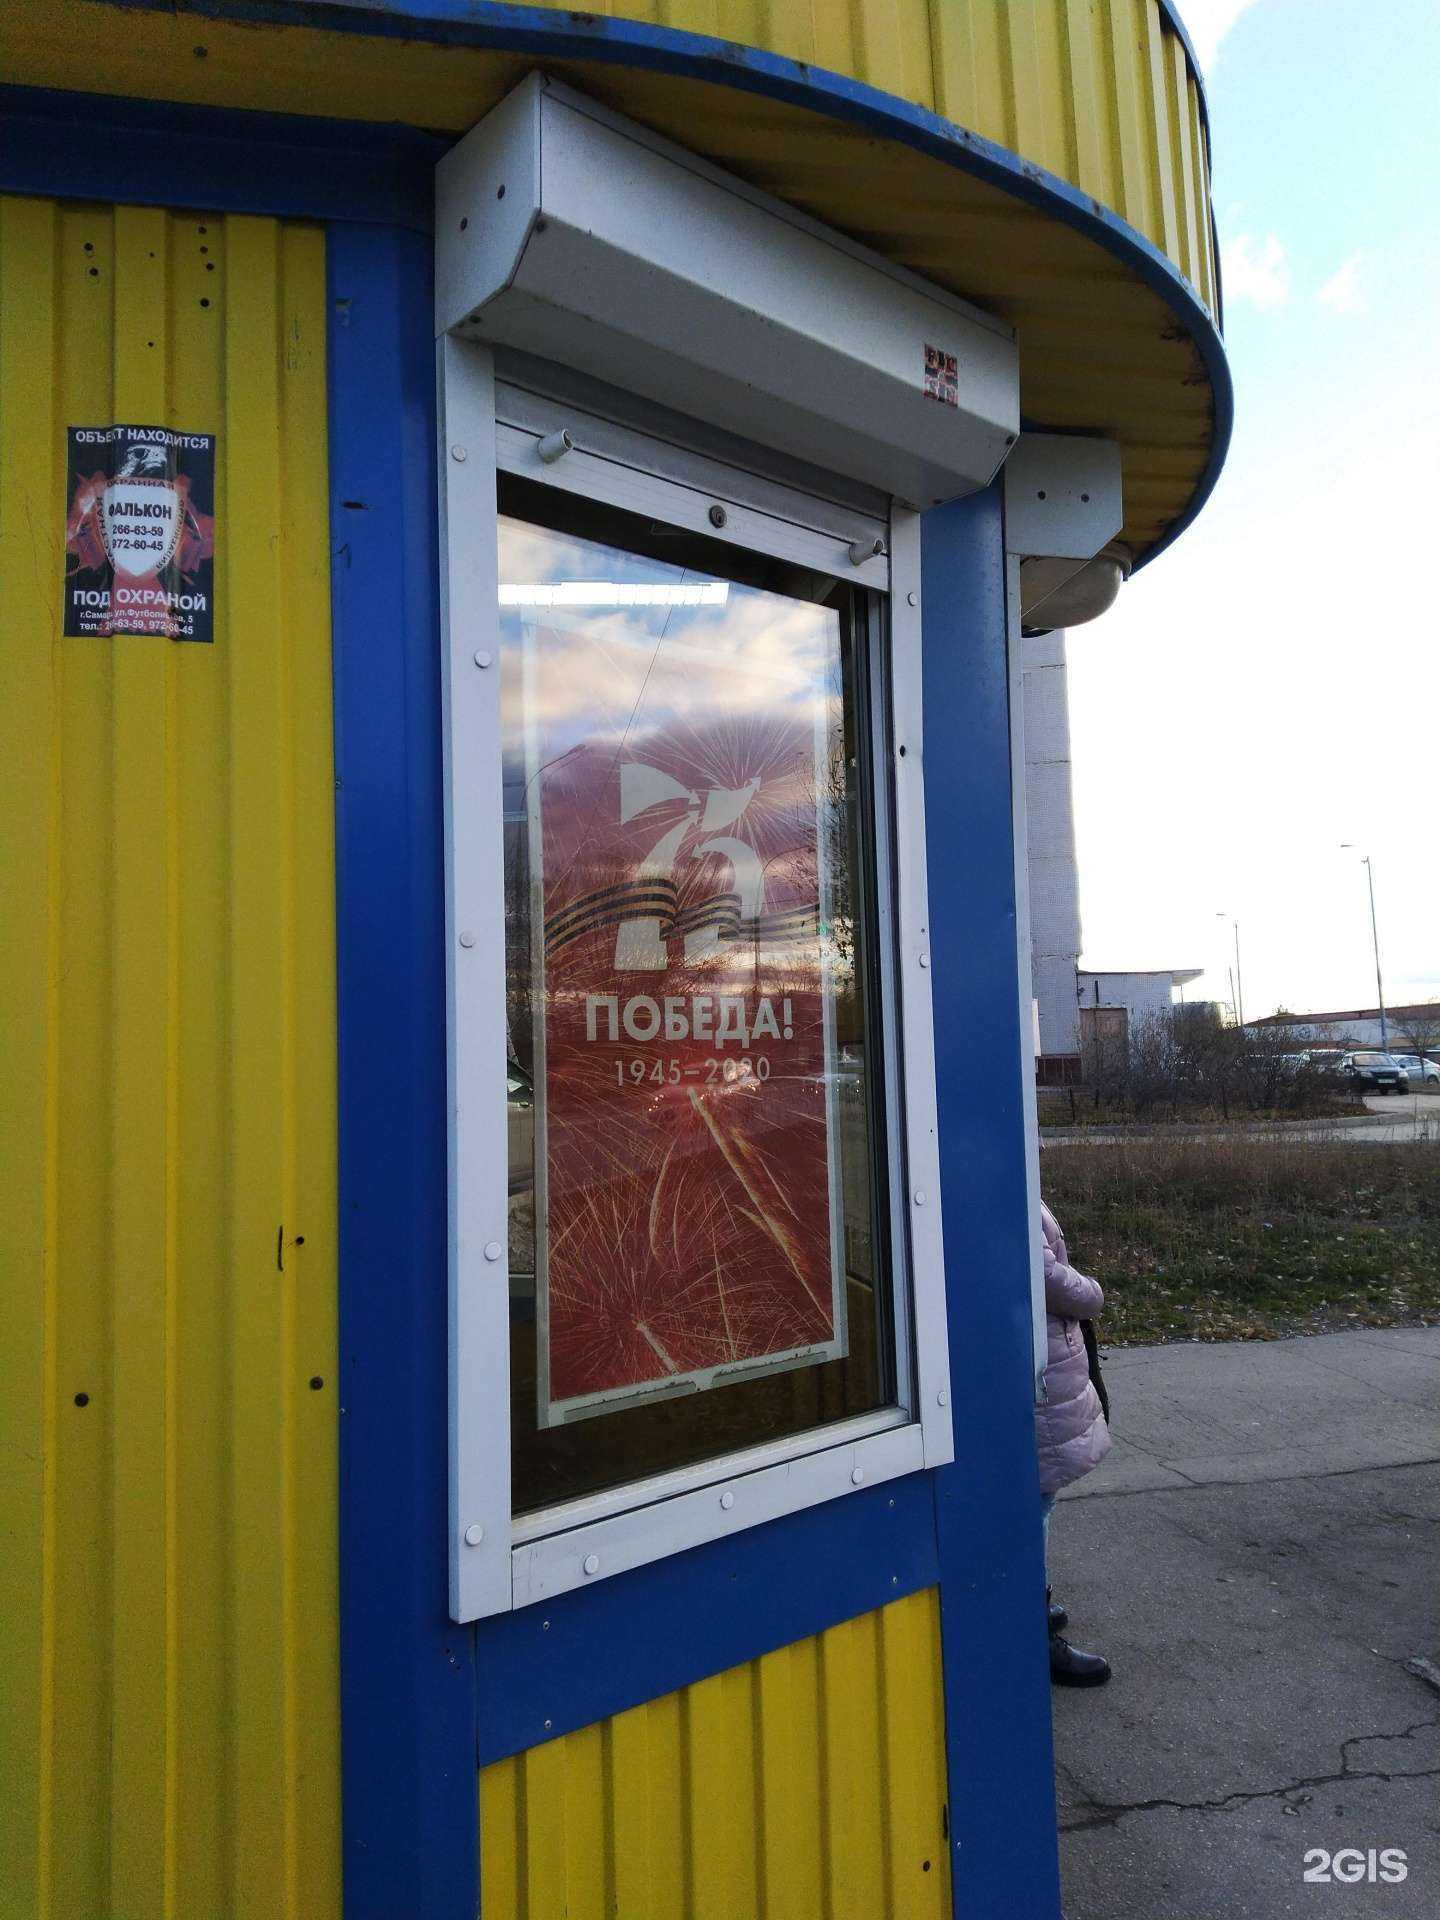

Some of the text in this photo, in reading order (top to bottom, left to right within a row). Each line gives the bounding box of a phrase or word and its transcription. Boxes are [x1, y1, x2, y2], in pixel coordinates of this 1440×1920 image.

[127, 429, 209, 449] НАХОДИТСЯ
[112, 524, 164, 537] 266-63-59
[73, 588, 206, 611] ПОД ОХРАНОЙ
[586, 995, 794, 1049] ПОБЕДА!
